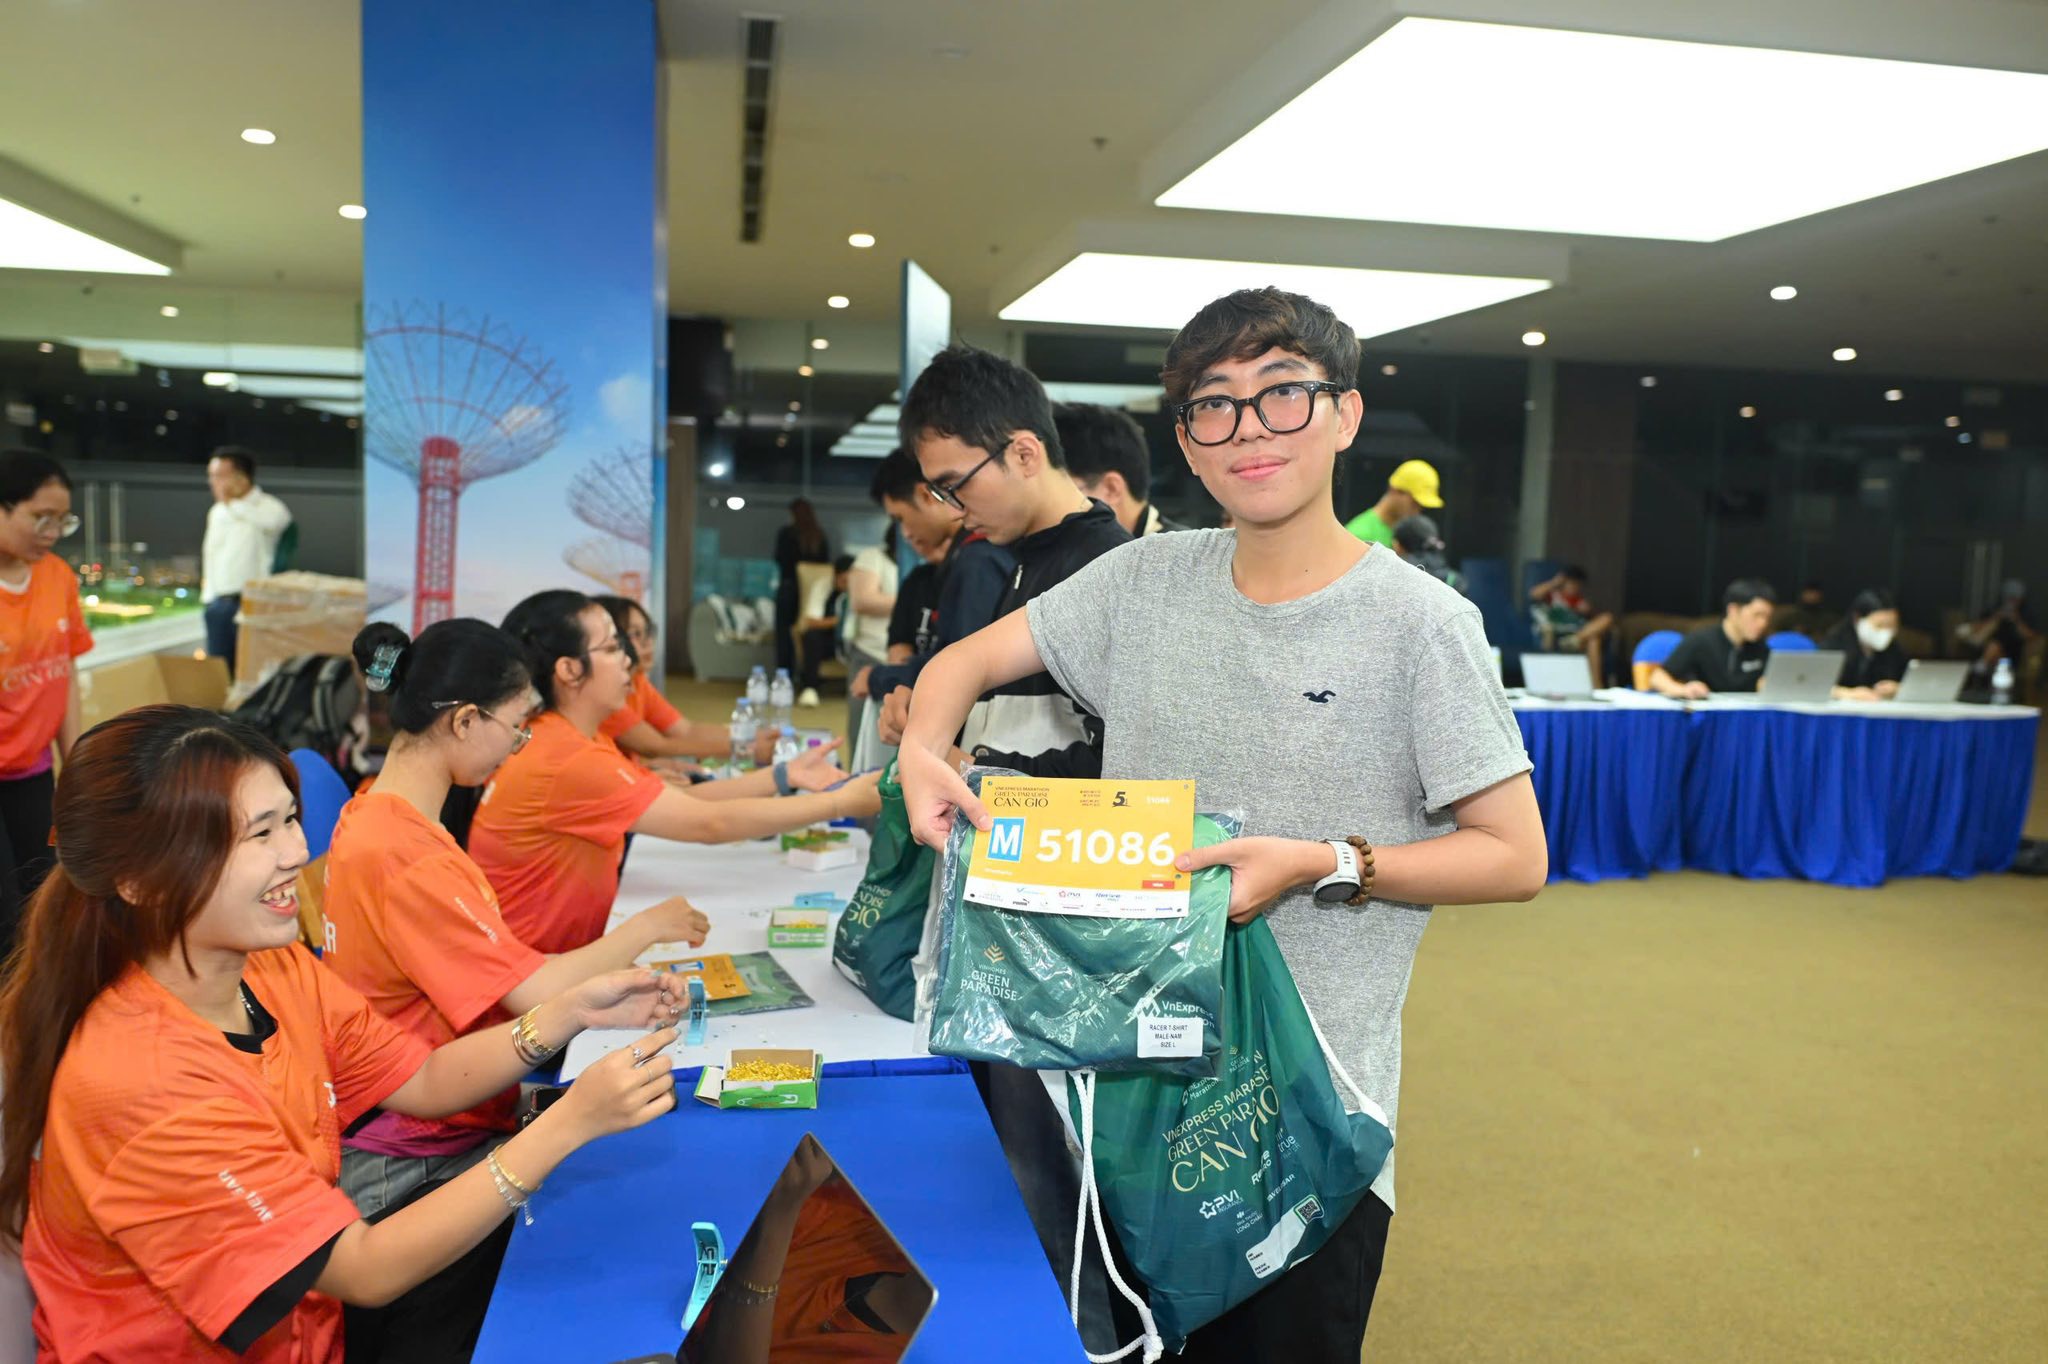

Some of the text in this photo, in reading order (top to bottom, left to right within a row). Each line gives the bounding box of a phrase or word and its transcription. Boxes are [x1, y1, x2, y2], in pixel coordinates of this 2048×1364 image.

[994, 797, 1048, 808] CAN GIO
[991, 824, 1022, 856] M
[1035, 828, 1175, 866] 51086
[960, 978, 1018, 1001] PARADISE
[971, 970, 1010, 988] GREEN
[1162, 1099, 1224, 1143] VNEXPRESS
[1168, 1122, 1219, 1162] GREEN
[1172, 1131, 1247, 1192] CAN
[1213, 1189, 1240, 1209] PVI
